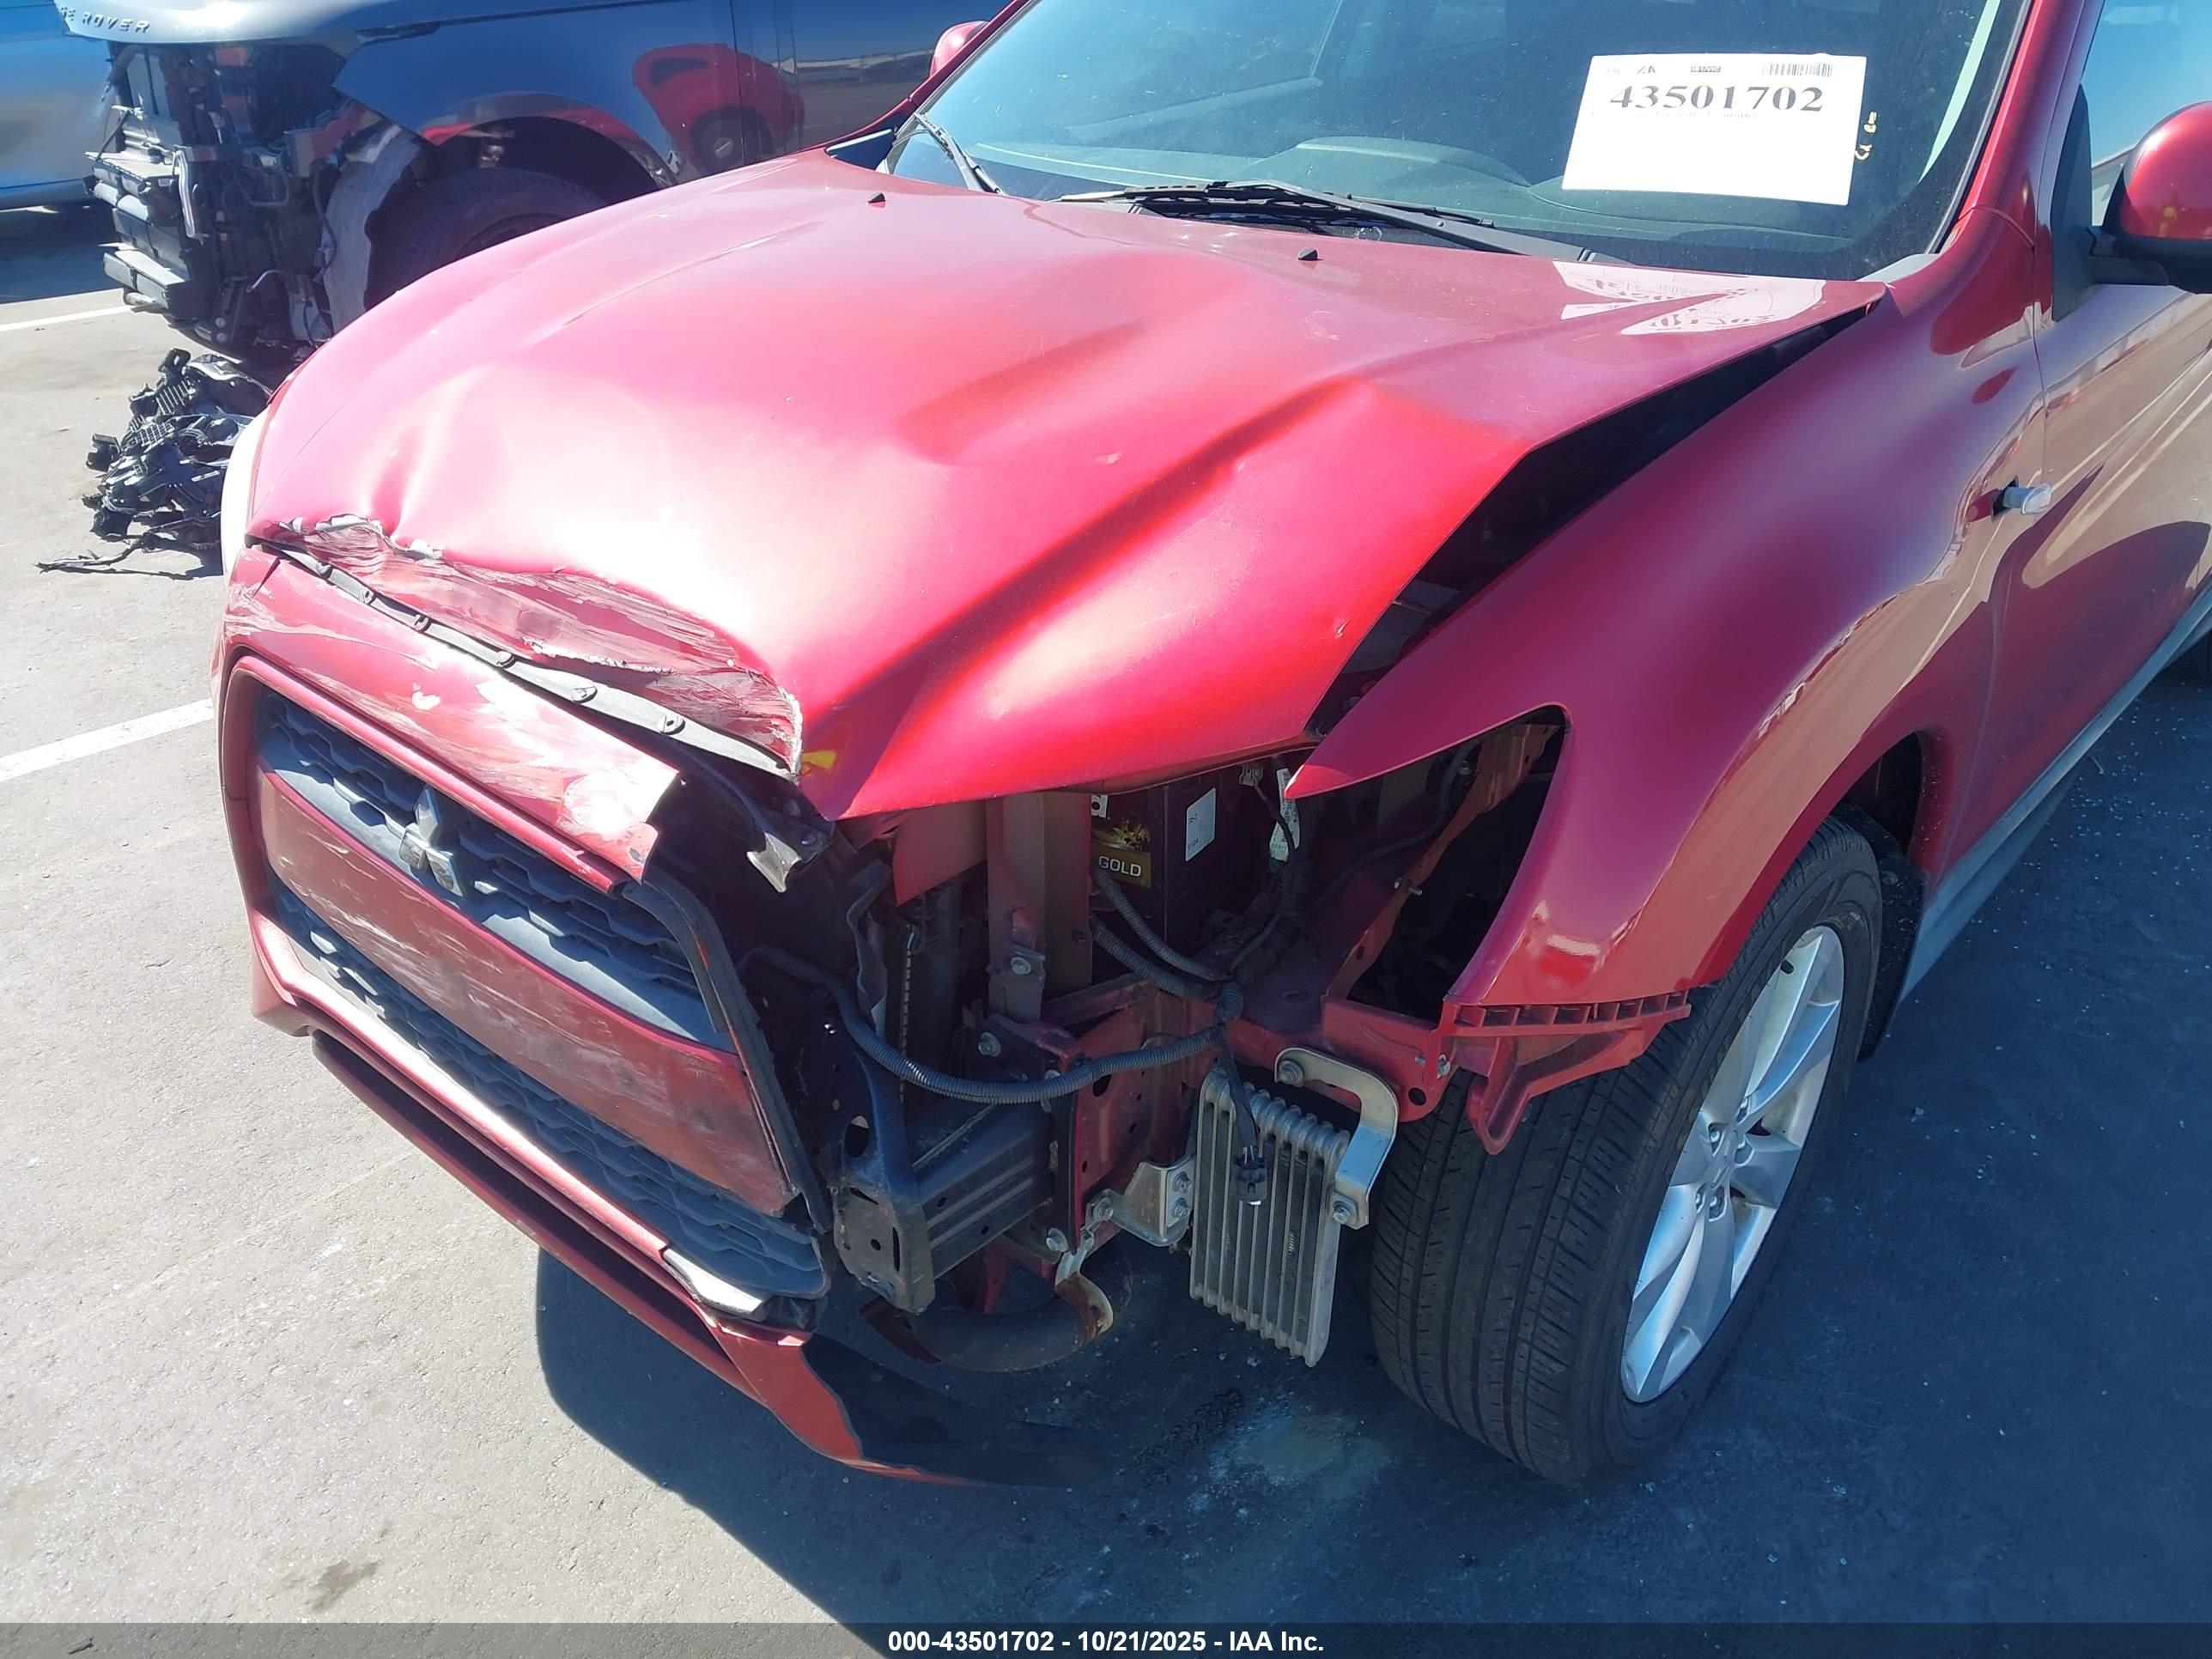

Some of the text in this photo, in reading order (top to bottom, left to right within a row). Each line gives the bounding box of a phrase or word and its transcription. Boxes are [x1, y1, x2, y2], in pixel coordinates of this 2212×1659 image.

[82, 11, 150, 33] ROVER
[1609, 85, 1824, 112] 43501702
[1098, 856, 1142, 877] GOLD
